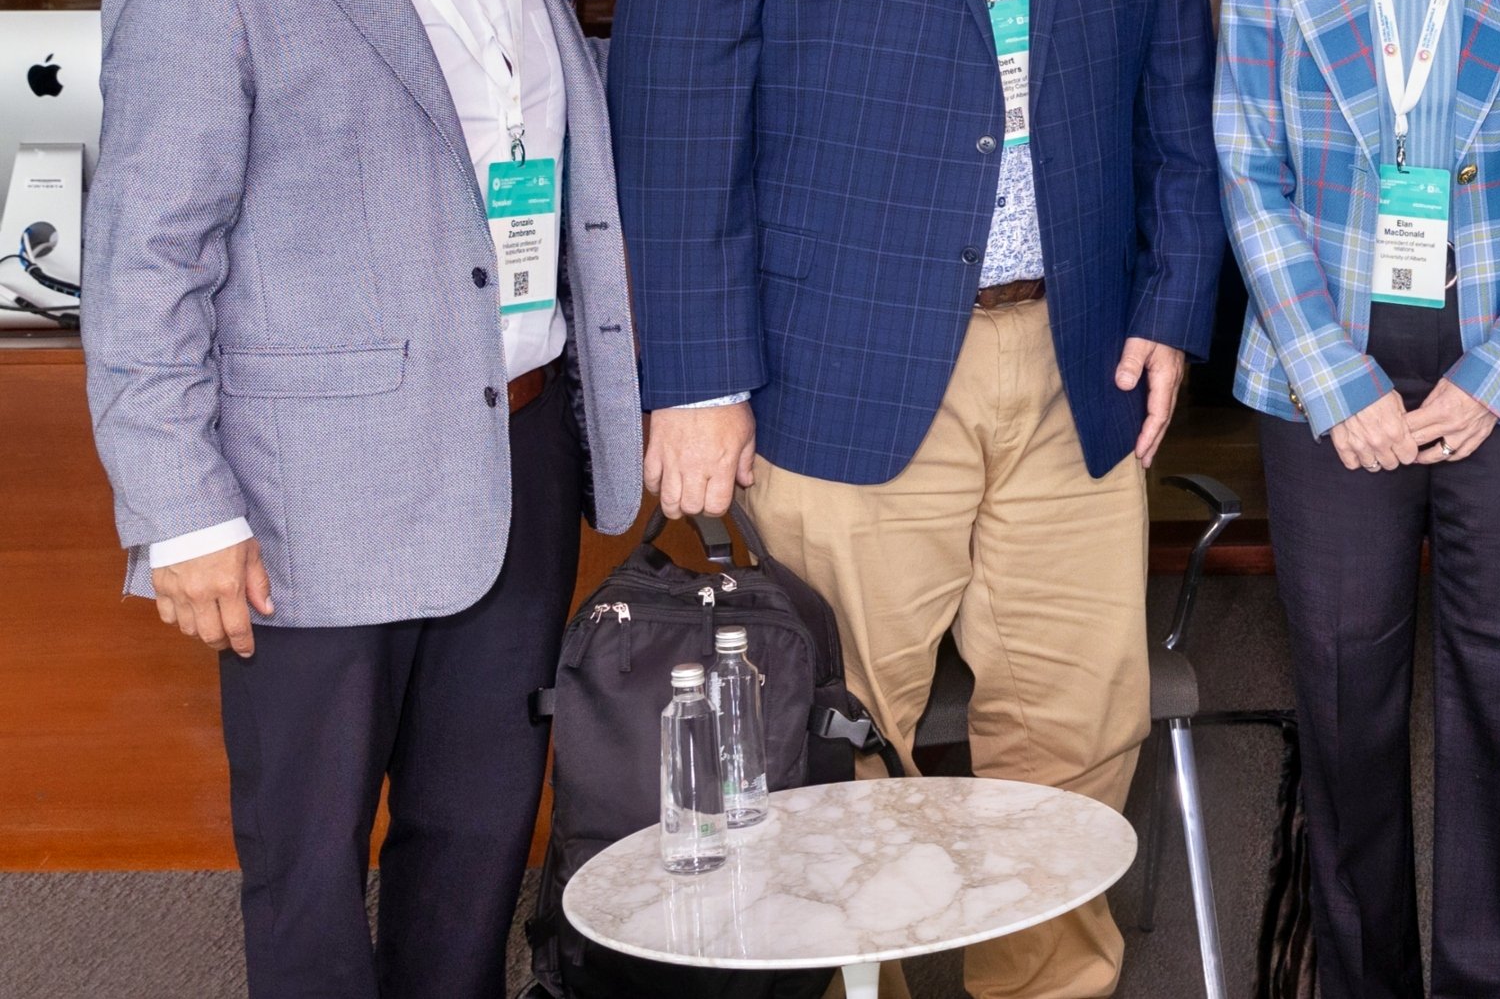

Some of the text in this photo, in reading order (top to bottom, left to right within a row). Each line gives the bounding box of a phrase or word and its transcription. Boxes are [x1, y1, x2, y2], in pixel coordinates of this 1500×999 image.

[511, 219, 533, 228] Gonzalo
[508, 229, 536, 238] Zambrano
[1384, 227, 1425, 239] MacDonald
